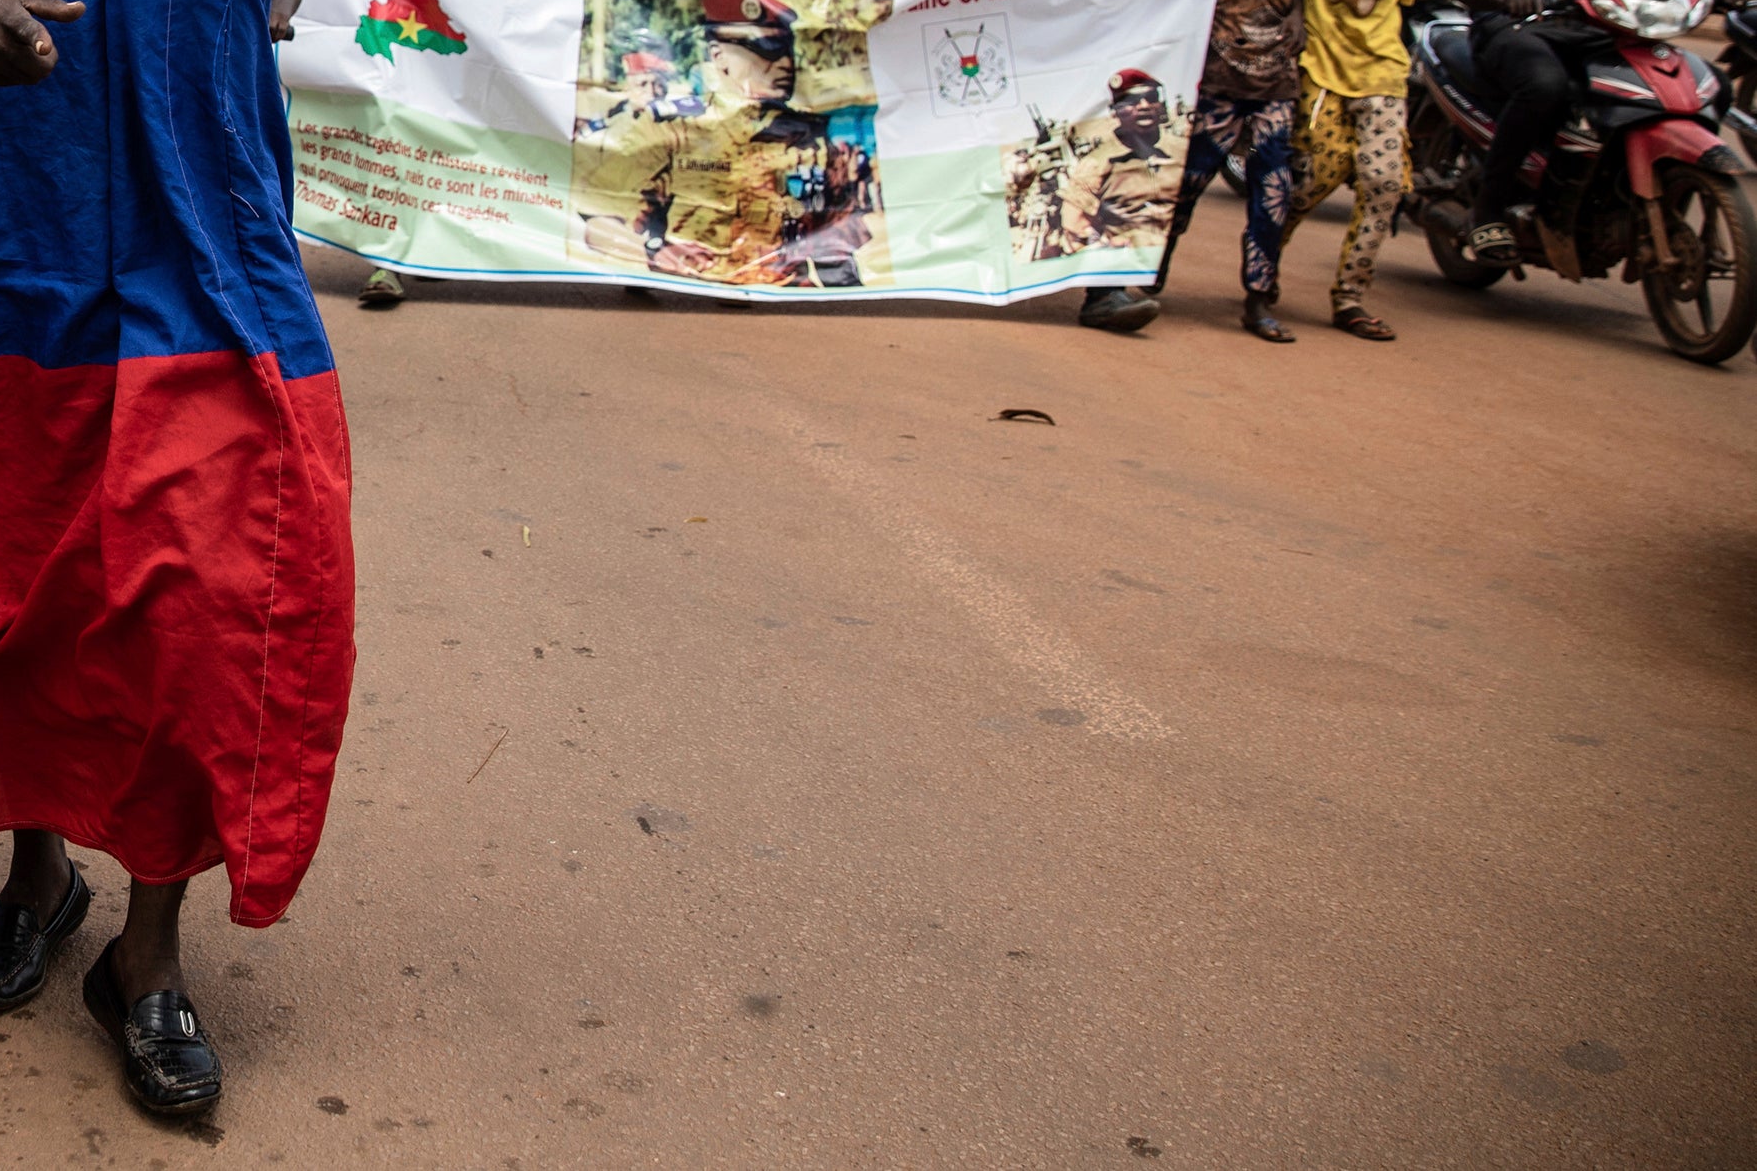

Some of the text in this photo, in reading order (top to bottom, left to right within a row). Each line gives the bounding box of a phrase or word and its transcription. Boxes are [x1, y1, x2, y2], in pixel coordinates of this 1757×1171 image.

[446, 180, 475, 196] sont
[479, 181, 499, 200] les
[503, 188, 563, 210] minables
